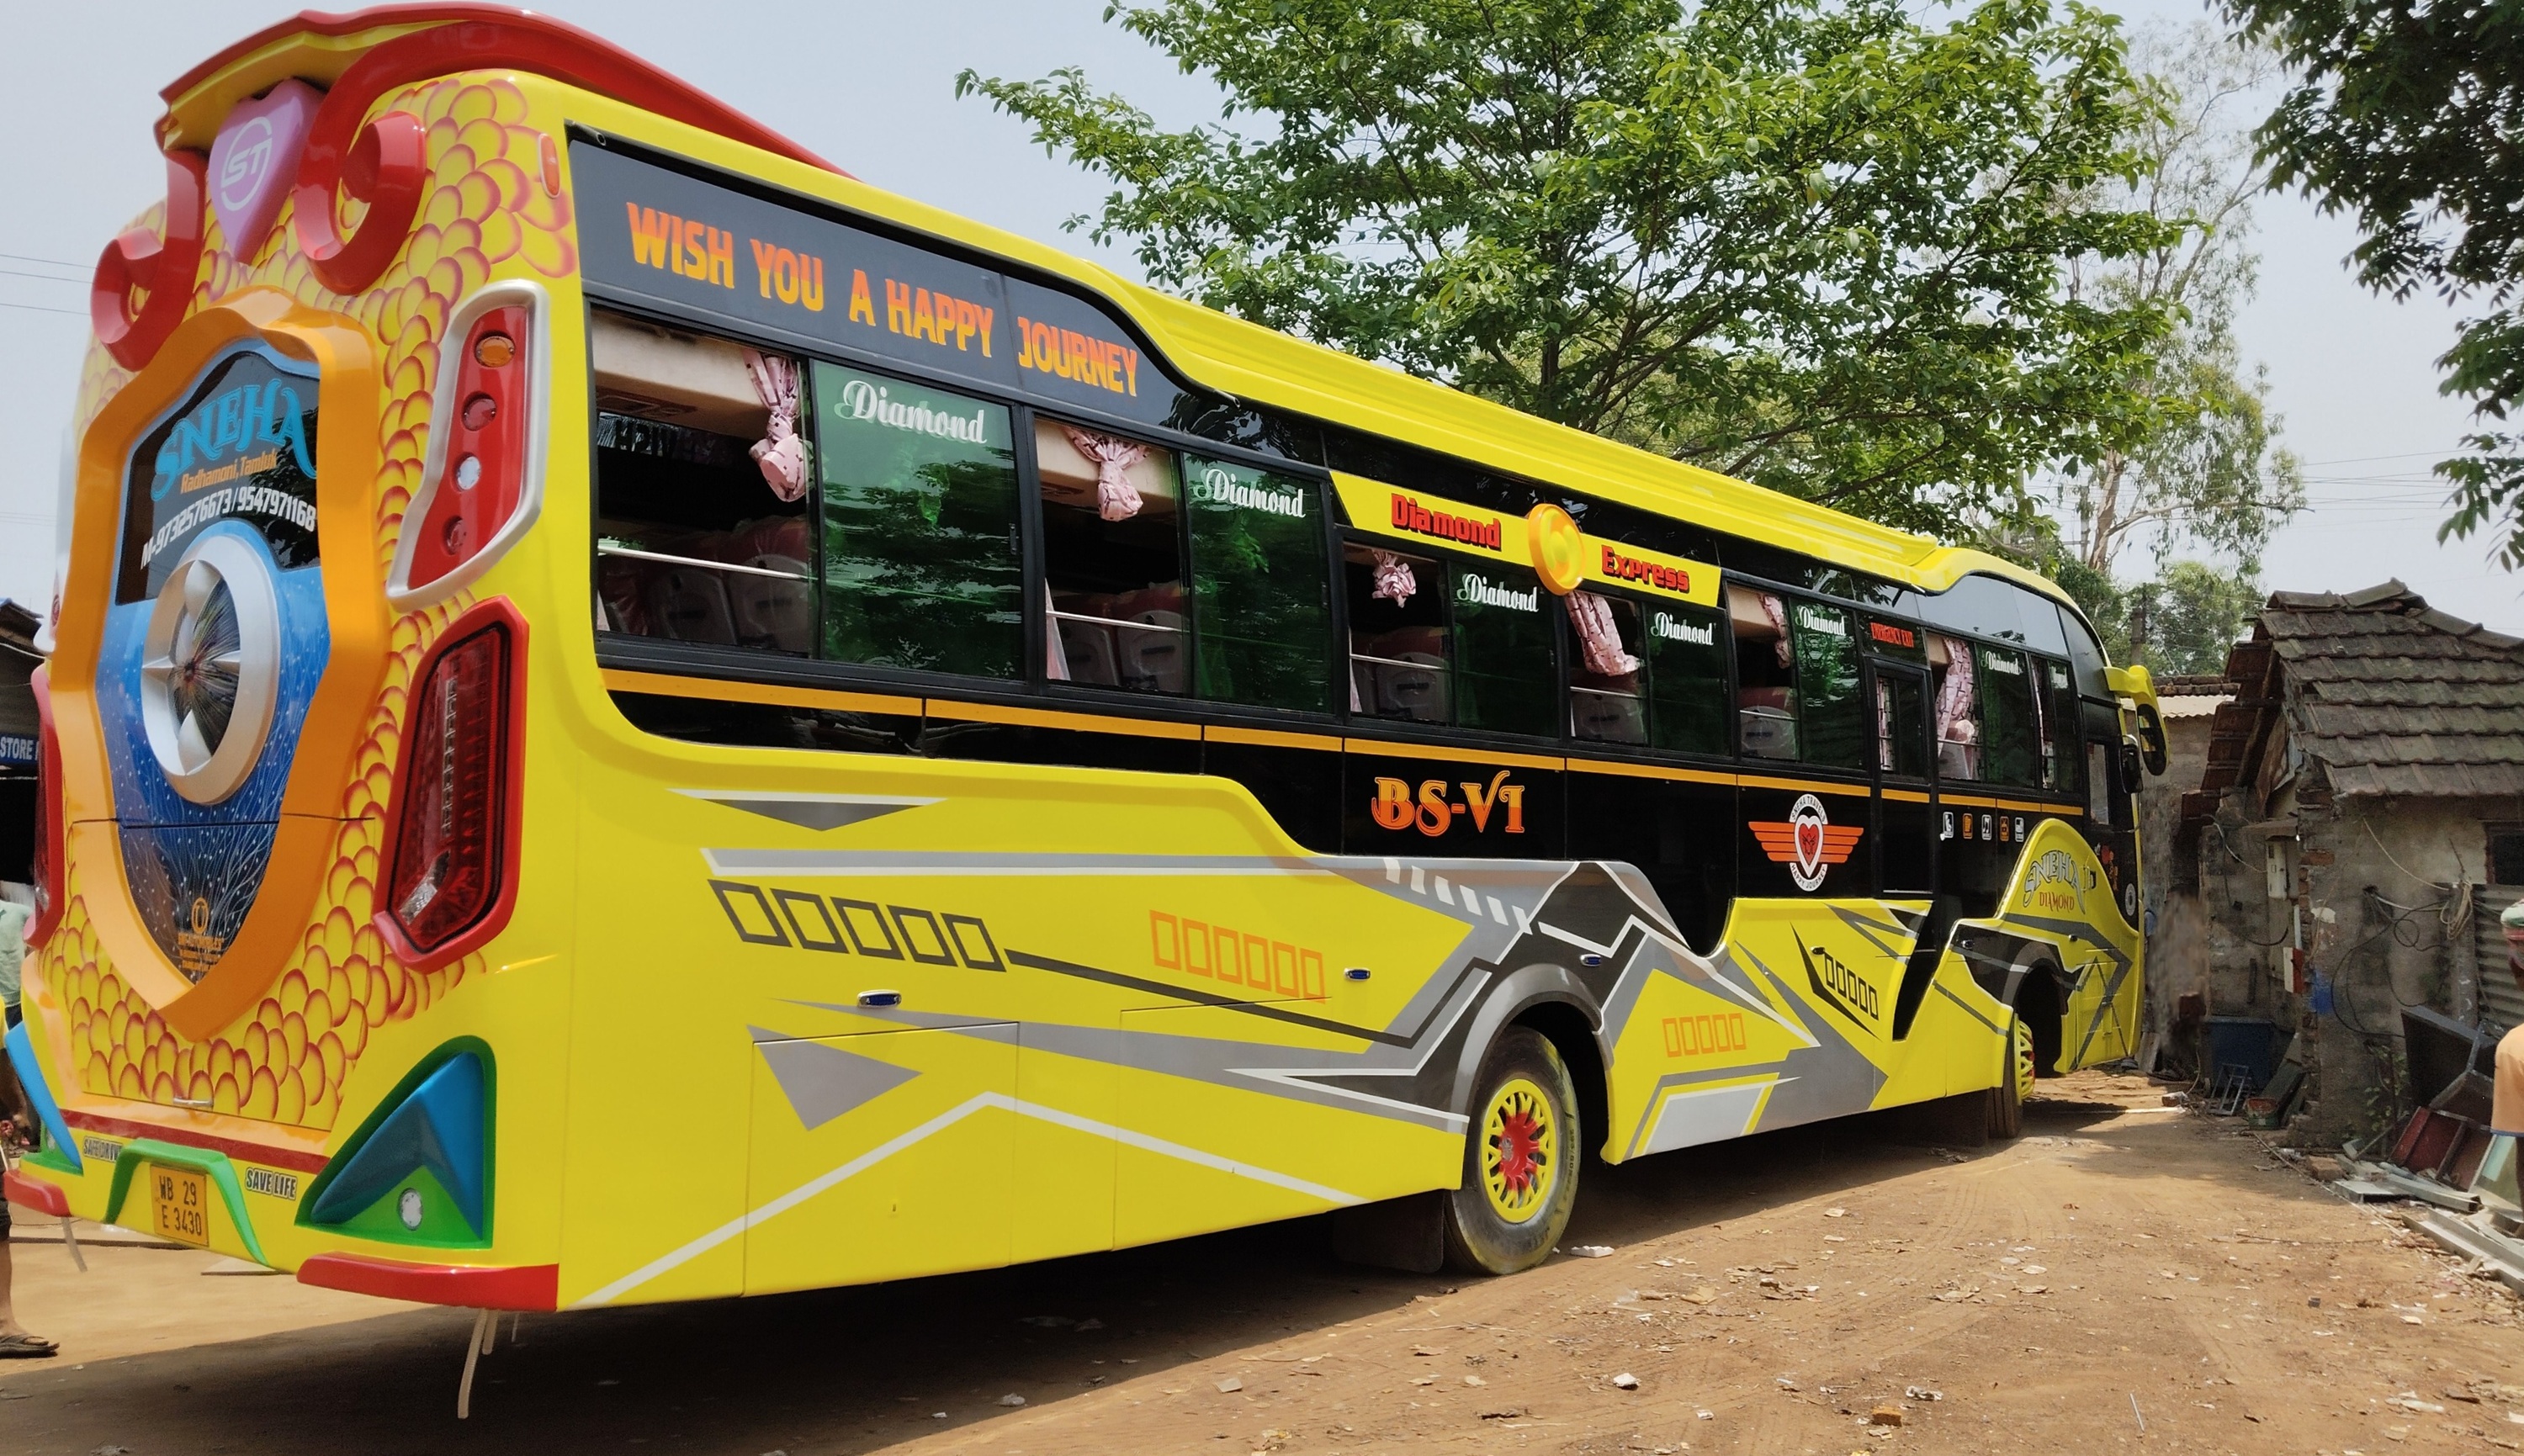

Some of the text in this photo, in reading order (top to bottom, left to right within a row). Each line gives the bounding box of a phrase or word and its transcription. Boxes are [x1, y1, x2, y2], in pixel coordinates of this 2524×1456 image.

[626, 202, 1137, 397] WISH YOU A HAPPY JOURNEY
[834, 380, 988, 444] Diamond
[151, 379, 317, 502] SNEHA
[240, 448, 278, 476] Tamluk
[1193, 469, 1306, 518] Diamond
[1391, 493, 1689, 594] Diamond Express
[1456, 573, 1540, 613] Diamond
[1650, 612, 1715, 647] Diamond
[1795, 606, 1847, 637] Diamond
[1980, 650, 2020, 675] Diamond
[0, 736, 34, 760] STORE
[1371, 770, 1525, 837] BS-VI
[1791, 797, 1806, 820] SNEHA
[1790, 864, 1827, 890] HAPPY JOURNEY
[2023, 850, 2086, 915] SNEHA
[2039, 892, 2075, 913] DIAMOND
[159, 1175, 173, 1201] WB
[183, 1180, 197, 1206] 29
[246, 1167, 297, 1201] SAVE LIFE
[162, 1204, 202, 1236] E 3430
